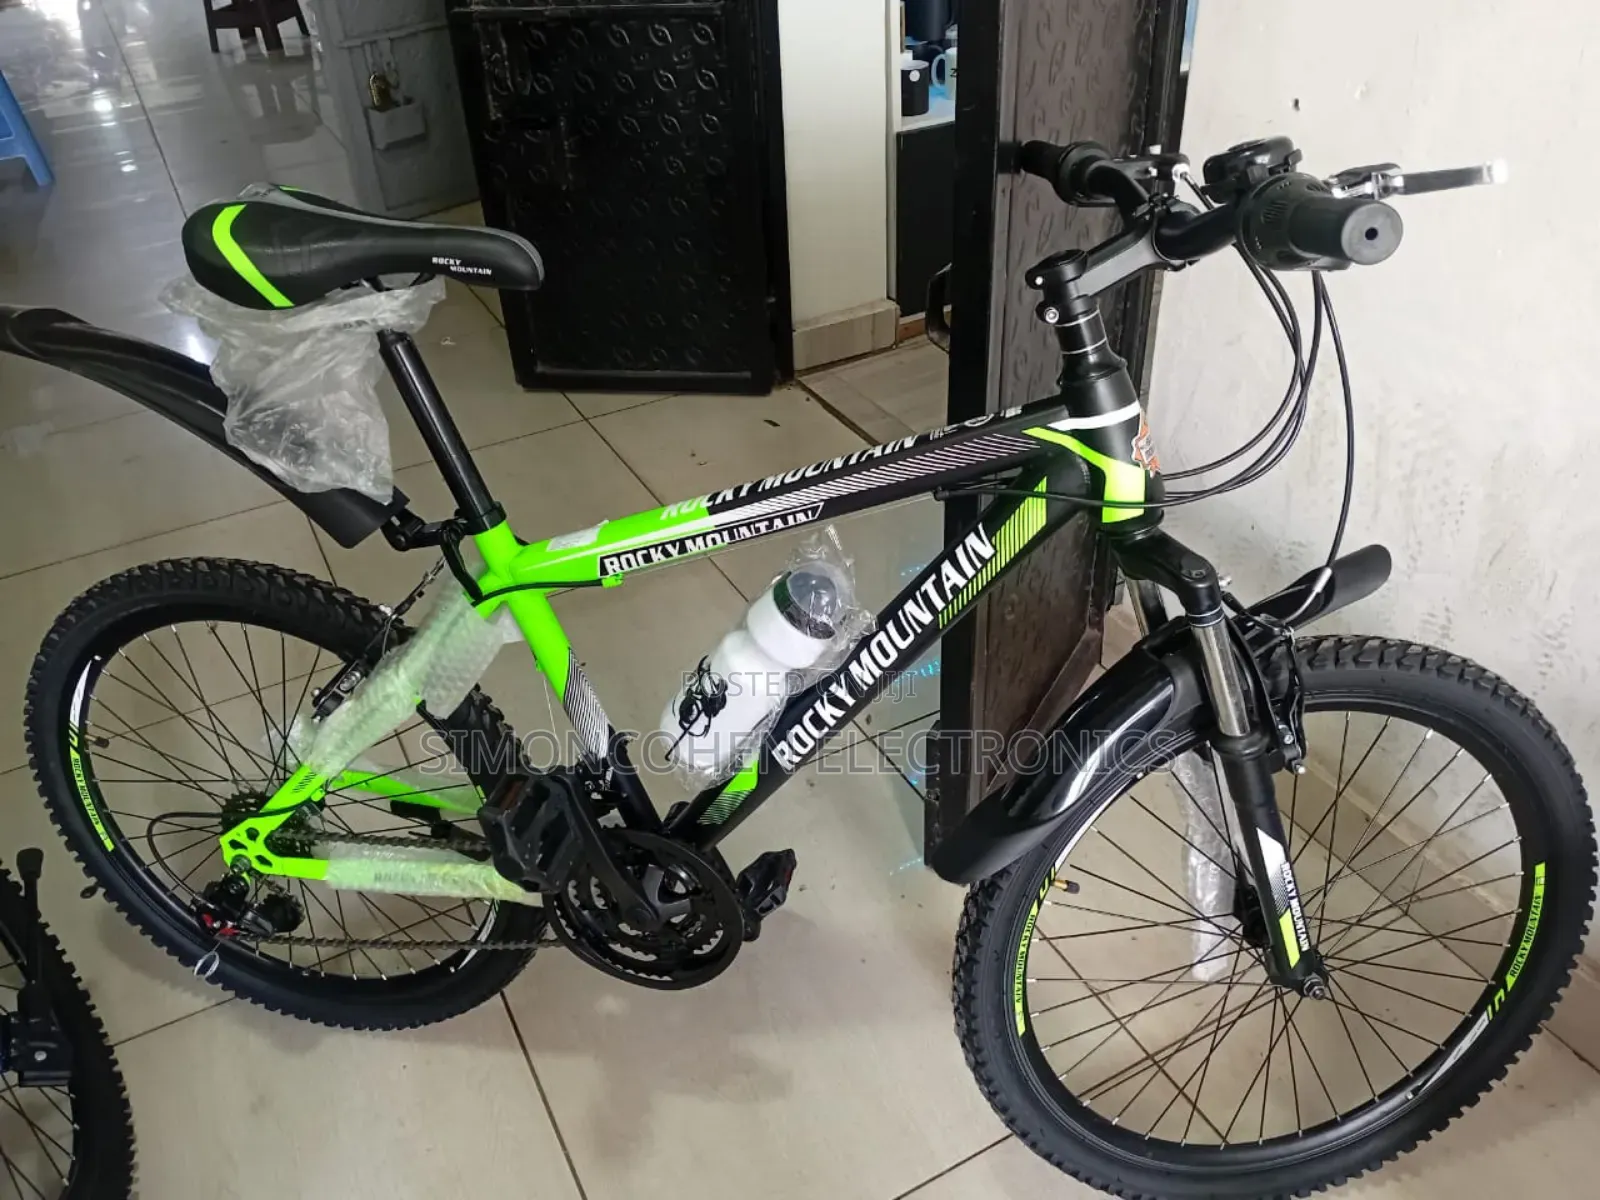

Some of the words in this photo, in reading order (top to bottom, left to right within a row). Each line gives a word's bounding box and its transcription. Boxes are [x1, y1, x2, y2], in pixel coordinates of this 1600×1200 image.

[432, 257, 461, 266] ROCKY
[450, 266, 492, 275] MOUNTAIN
[603, 544, 681, 575] ROCKY
[771, 674, 856, 771] ROCKY
[849, 523, 995, 690] MOUNTAIN
